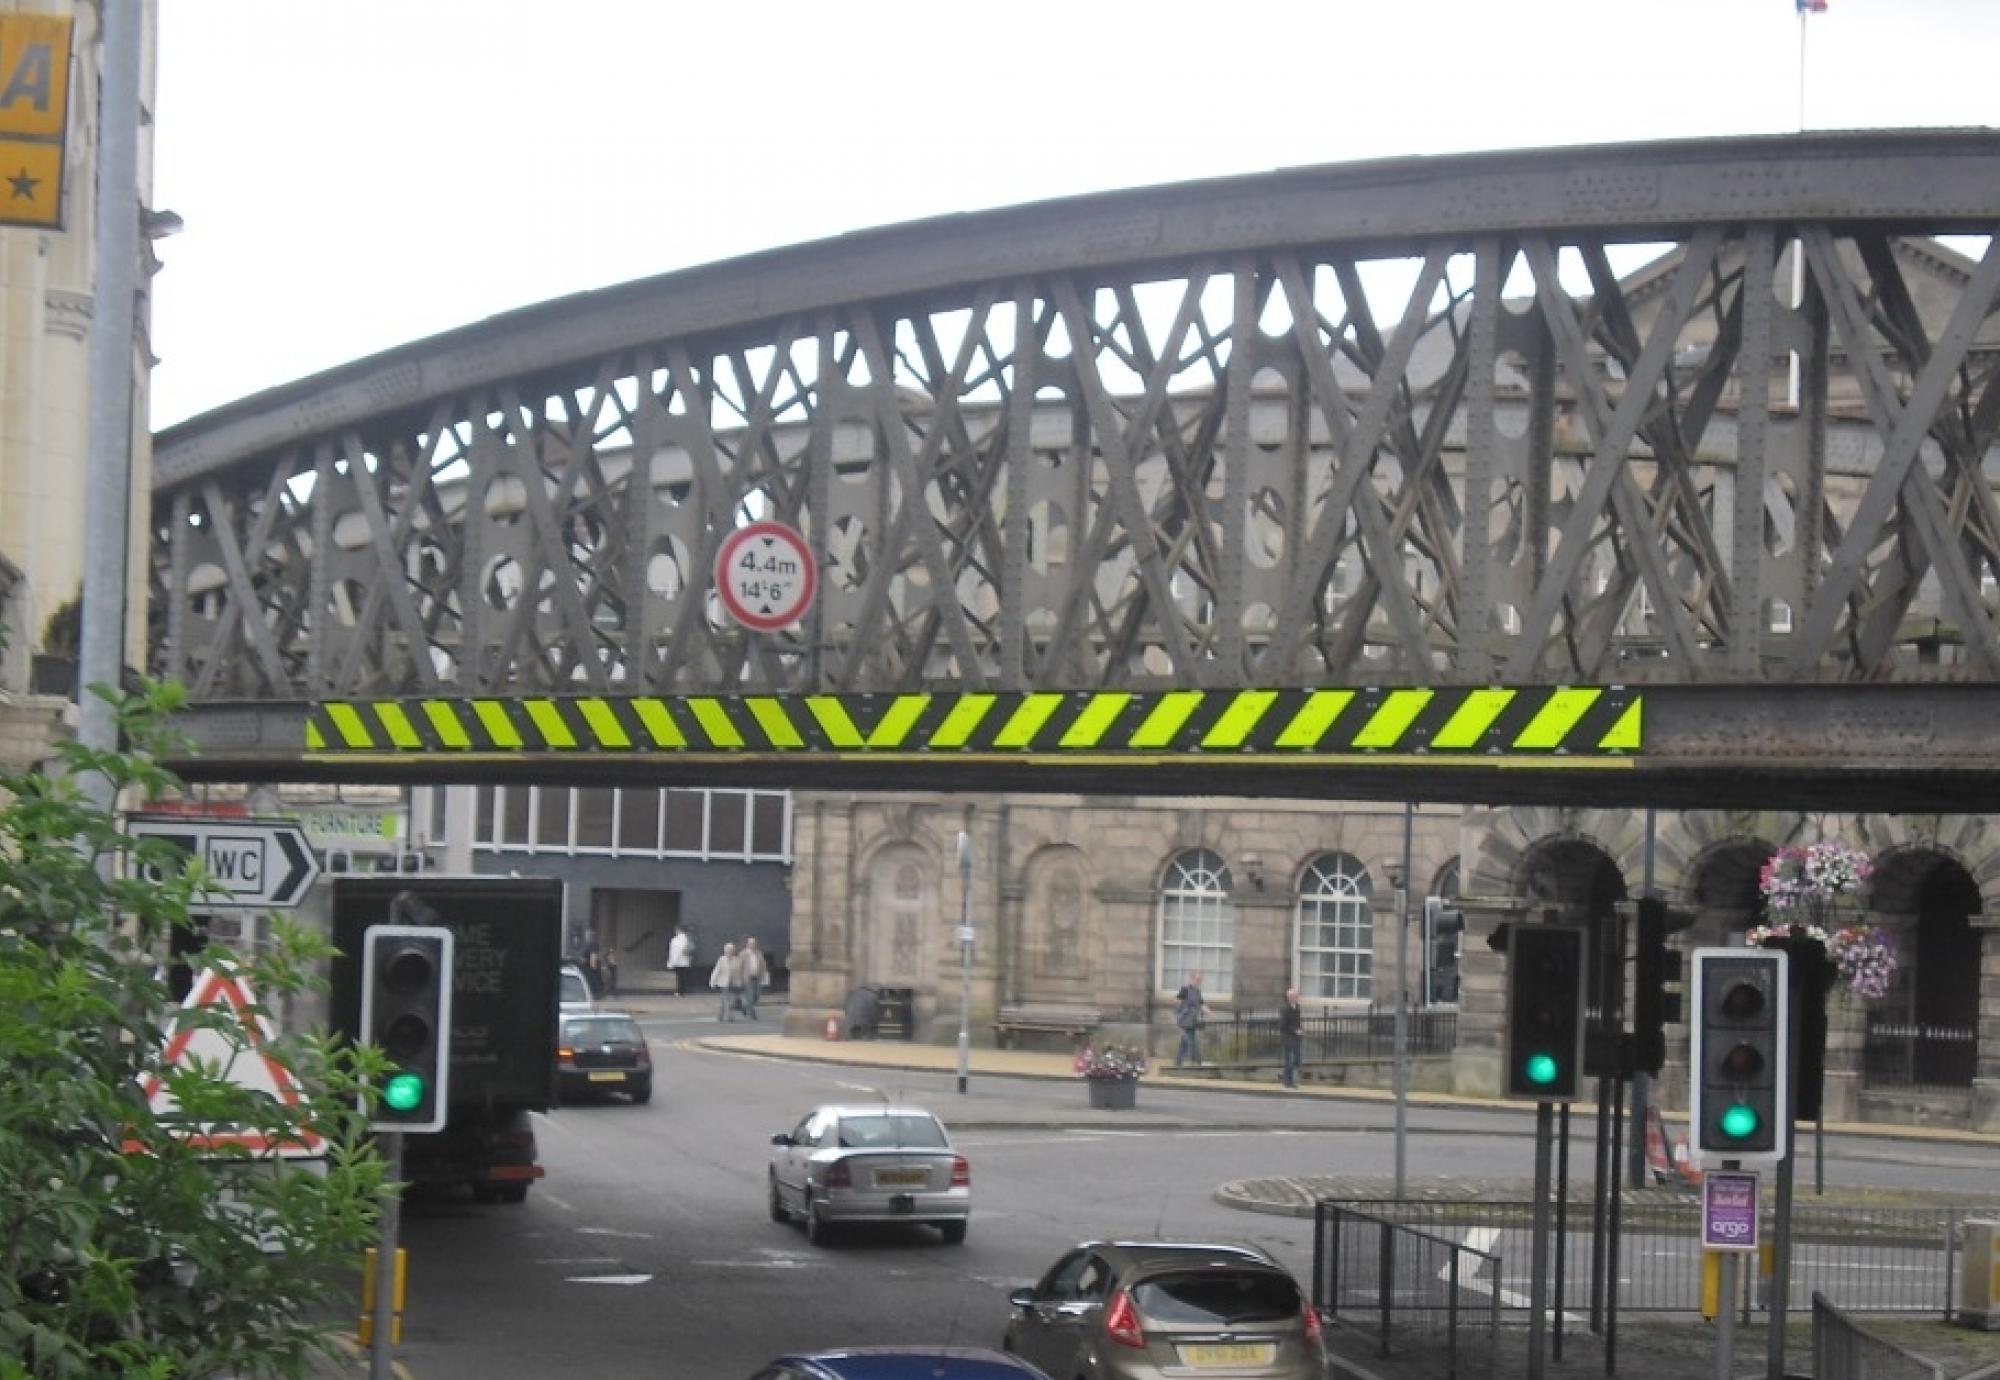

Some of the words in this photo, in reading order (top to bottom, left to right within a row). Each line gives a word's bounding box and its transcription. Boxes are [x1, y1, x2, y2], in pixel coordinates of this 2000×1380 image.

[0, 43, 52, 112] A
[740, 551, 796, 574] 4.4m
[311, 811, 383, 834] FURNITURE
[212, 849, 258, 881] WC
